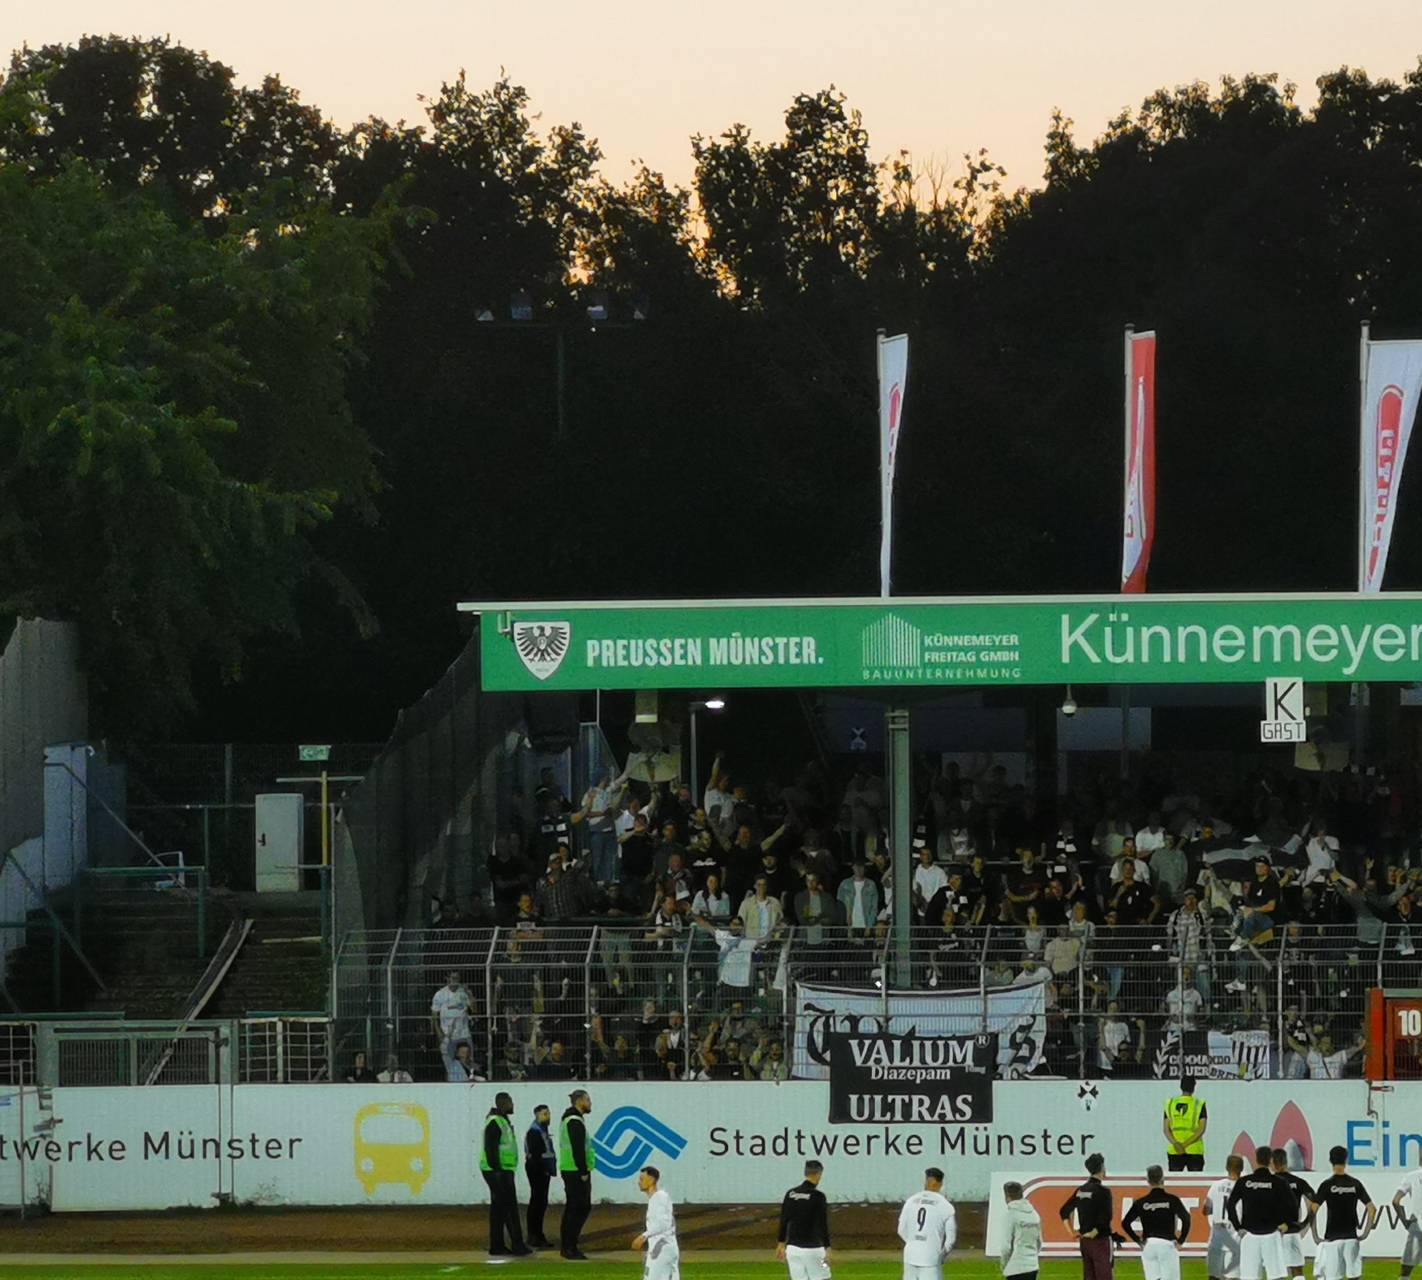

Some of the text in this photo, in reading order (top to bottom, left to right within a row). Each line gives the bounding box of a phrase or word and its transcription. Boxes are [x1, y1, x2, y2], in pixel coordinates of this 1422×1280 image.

[586, 631, 824, 668] PREUSSEN MÜNSTER.
[924, 633, 1020, 647] KÜNNEMEYER
[924, 650, 1020, 663] FREITAG GMBH
[862, 667, 1022, 680] BAUUNTERNEHMUNG
[1273, 681, 1298, 721] K
[1262, 722, 1304, 740] GAST
[1397, 1008, 1422, 1037] 10
[848, 1039, 976, 1067] VALIUM
[871, 1065, 951, 1083] Diazepam
[848, 1094, 973, 1121] ULTRAS
[143, 1131, 303, 1161] Münster
[709, 1126, 1096, 1157] Stadtwerke Münster
[916, 1206, 927, 1232] 9
